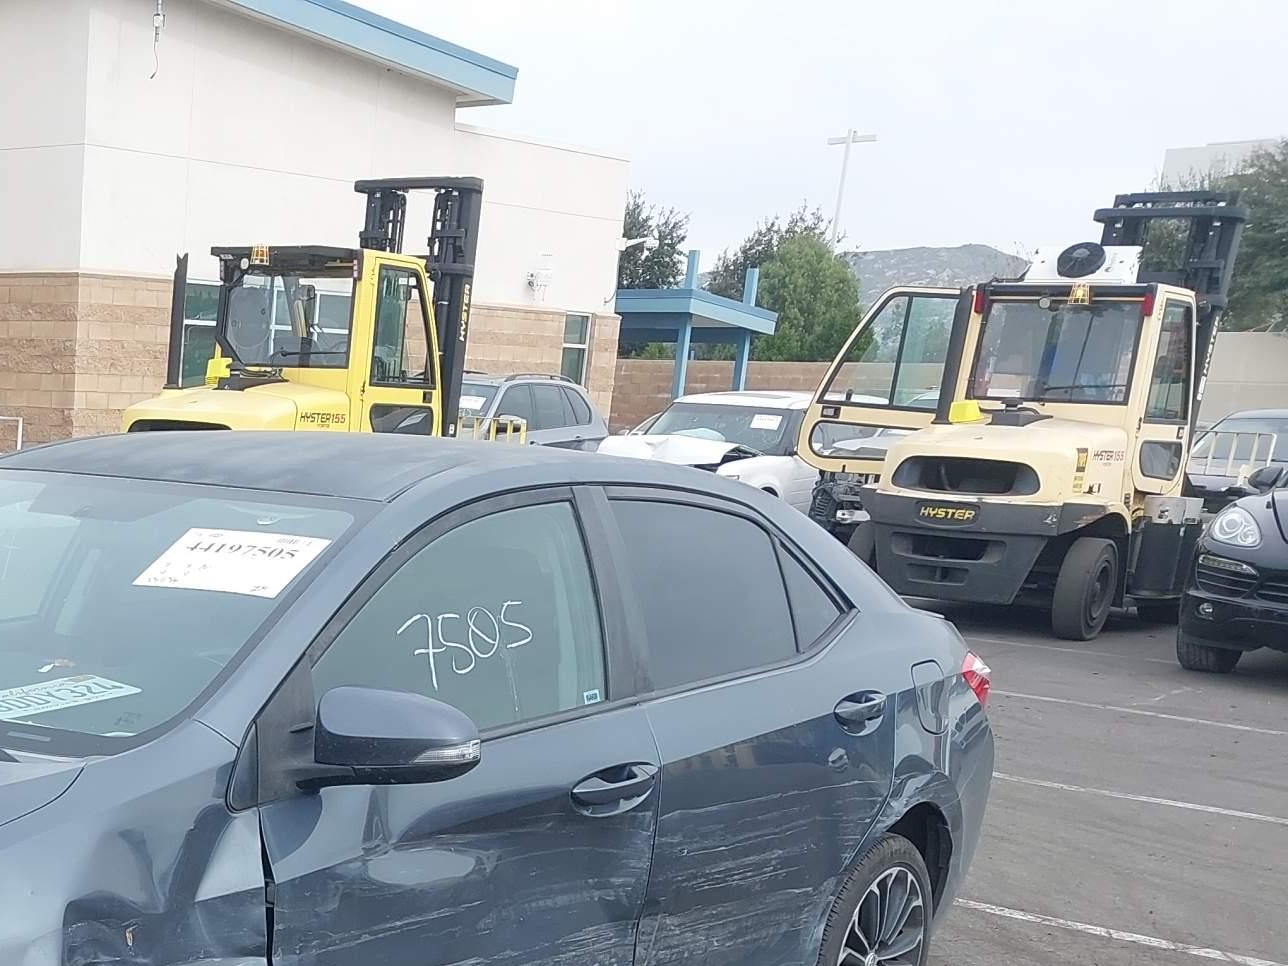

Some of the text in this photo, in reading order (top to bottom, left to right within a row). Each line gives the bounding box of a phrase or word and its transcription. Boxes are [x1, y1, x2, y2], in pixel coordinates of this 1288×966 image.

[919, 506, 976, 521] HYSTER
[185, 541, 300, 560] 44197505
[396, 600, 533, 691] 7505
